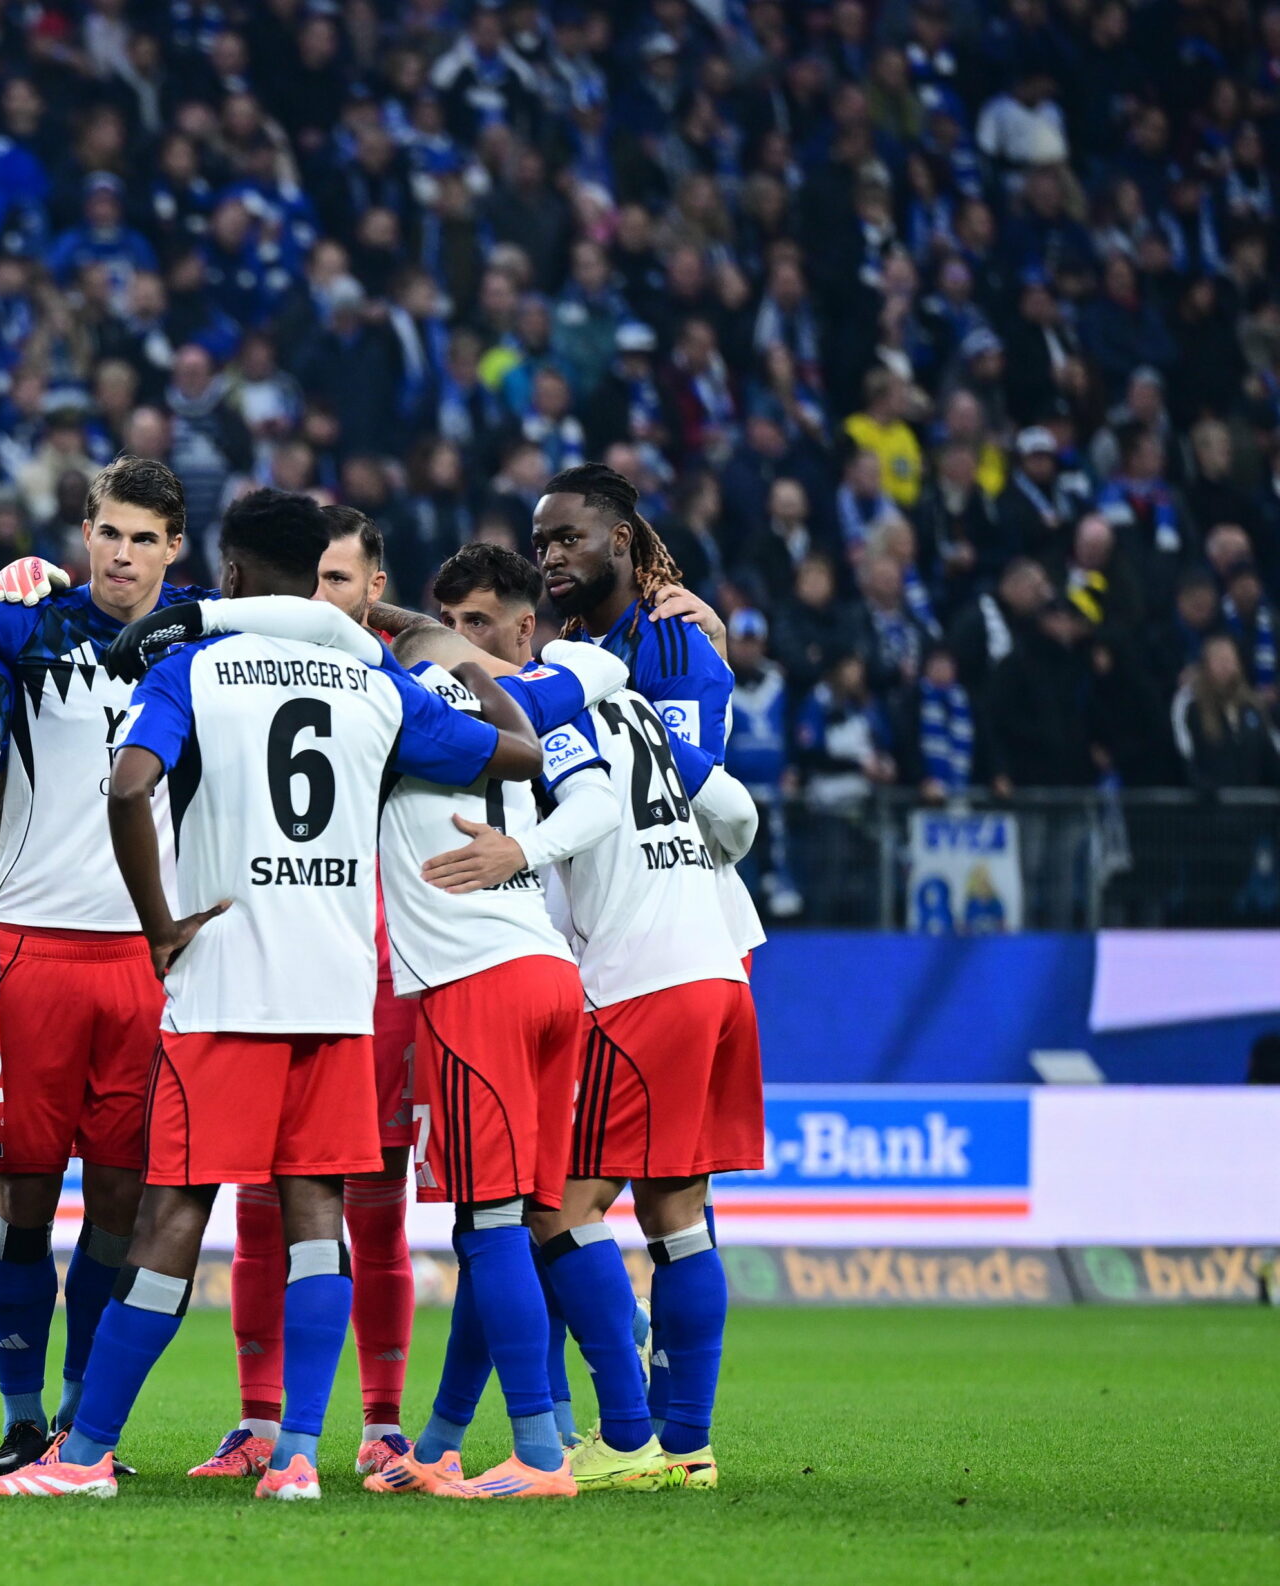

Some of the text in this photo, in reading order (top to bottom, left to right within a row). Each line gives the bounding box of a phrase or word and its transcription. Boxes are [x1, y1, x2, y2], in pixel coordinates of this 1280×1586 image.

[214, 659, 368, 694] HAMBURGER SV
[267, 697, 336, 843] 6
[548, 745, 584, 768] PLAN
[597, 698, 690, 831] 28
[250, 857, 358, 887] SAMBI
[412, 1103, 431, 1164] 7
[783, 1246, 1051, 1300] buXtrade
